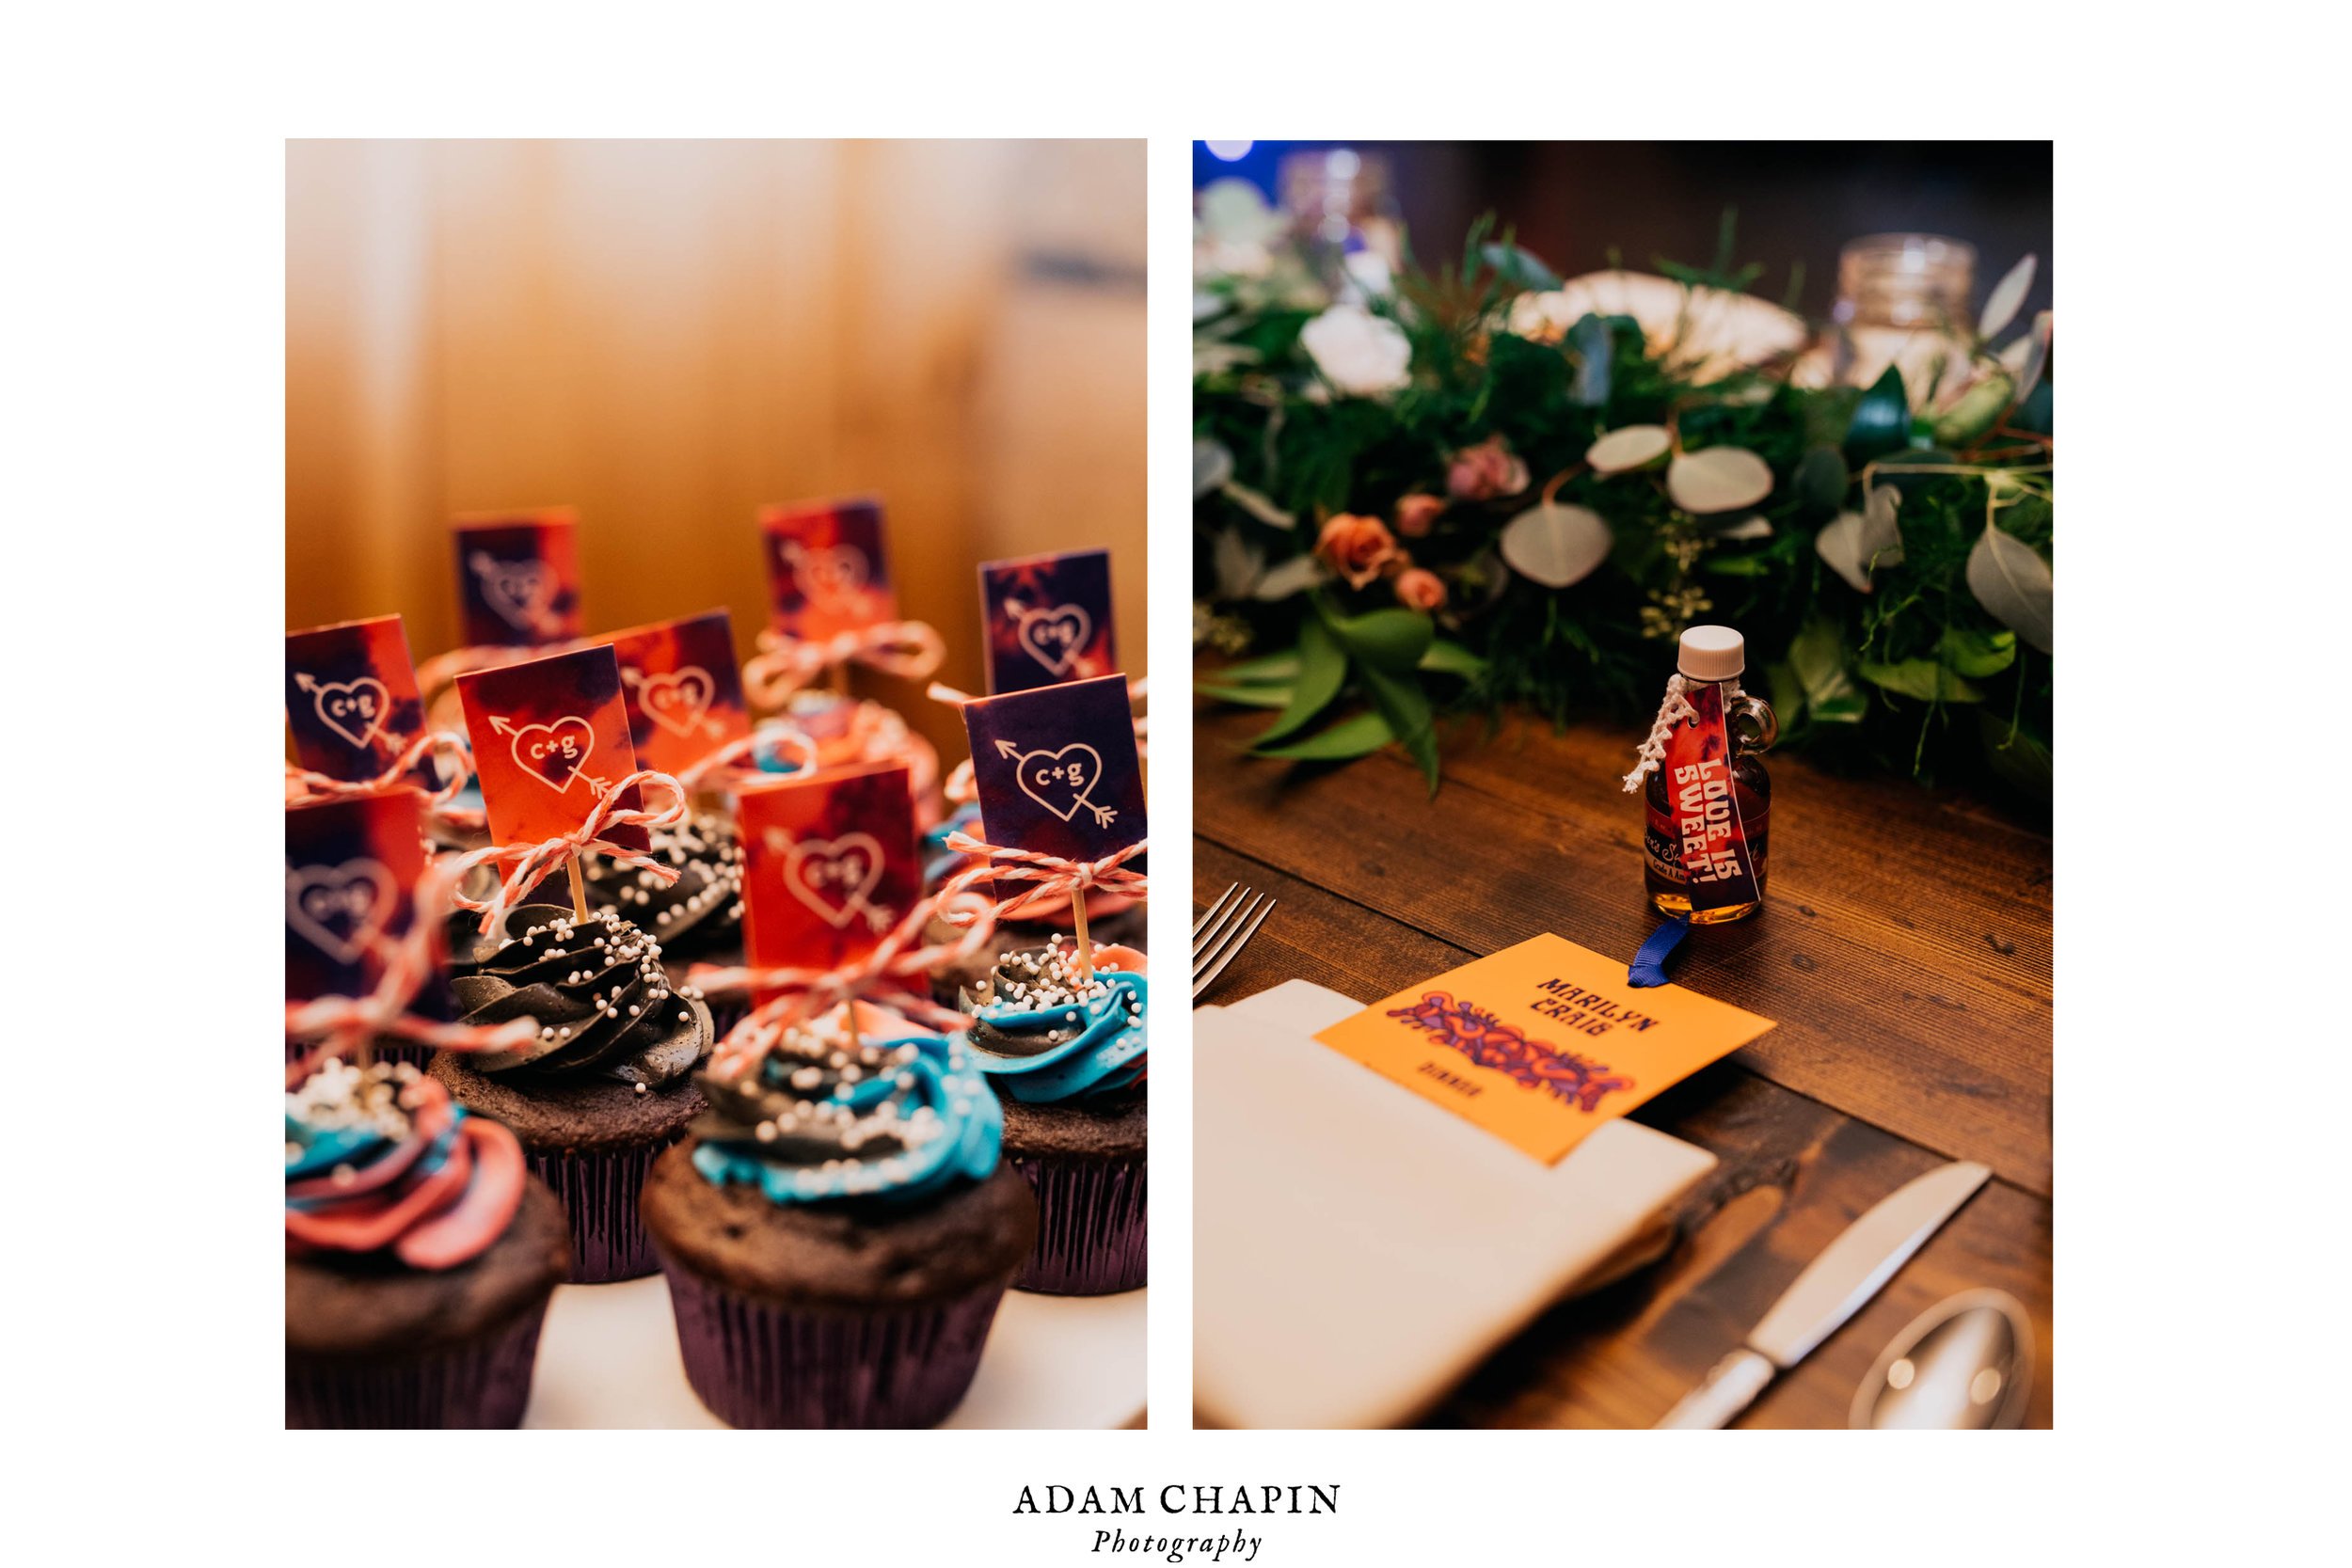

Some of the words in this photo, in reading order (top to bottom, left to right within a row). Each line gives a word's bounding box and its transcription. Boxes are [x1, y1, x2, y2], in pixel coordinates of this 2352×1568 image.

[331, 695, 375, 718] c+g
[531, 736, 578, 759] c+g
[1036, 763, 1085, 786] c+g
[1697, 758, 1731, 842] LOVE
[1675, 764, 1718, 883] SWEET!
[1710, 848, 1742, 879] IS
[1530, 998, 1613, 1036] CRAIG
[1536, 978, 1659, 1031] MARILYN
